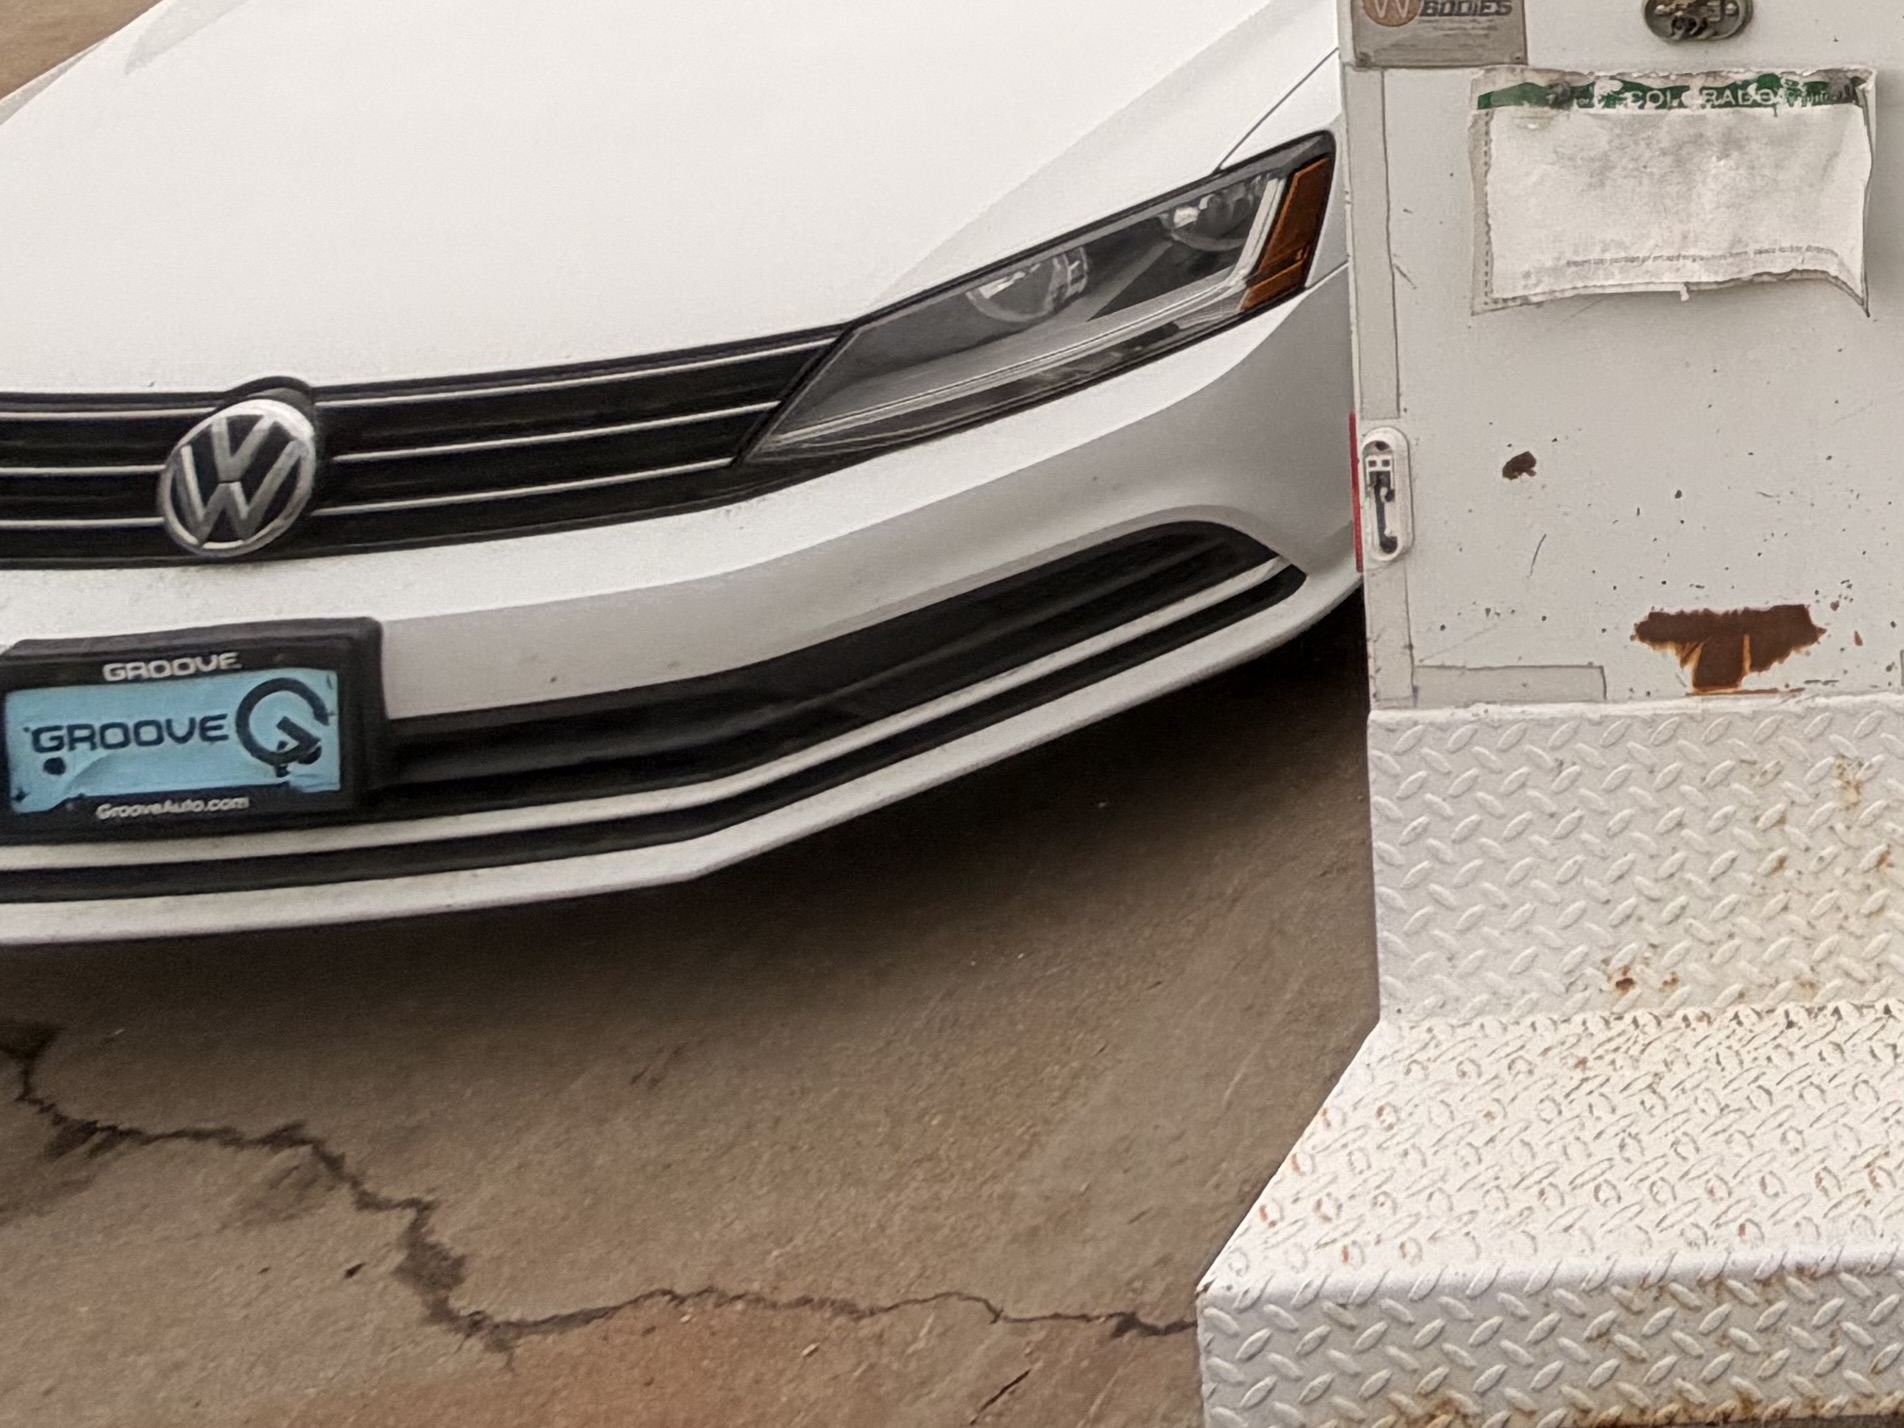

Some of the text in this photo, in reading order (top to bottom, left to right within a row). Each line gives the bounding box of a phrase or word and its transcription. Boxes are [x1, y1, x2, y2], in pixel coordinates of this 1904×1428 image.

[102, 652, 242, 682] GROOVE
[31, 713, 230, 754] GROOVE
[95, 796, 250, 821] GrooveAuto.com
